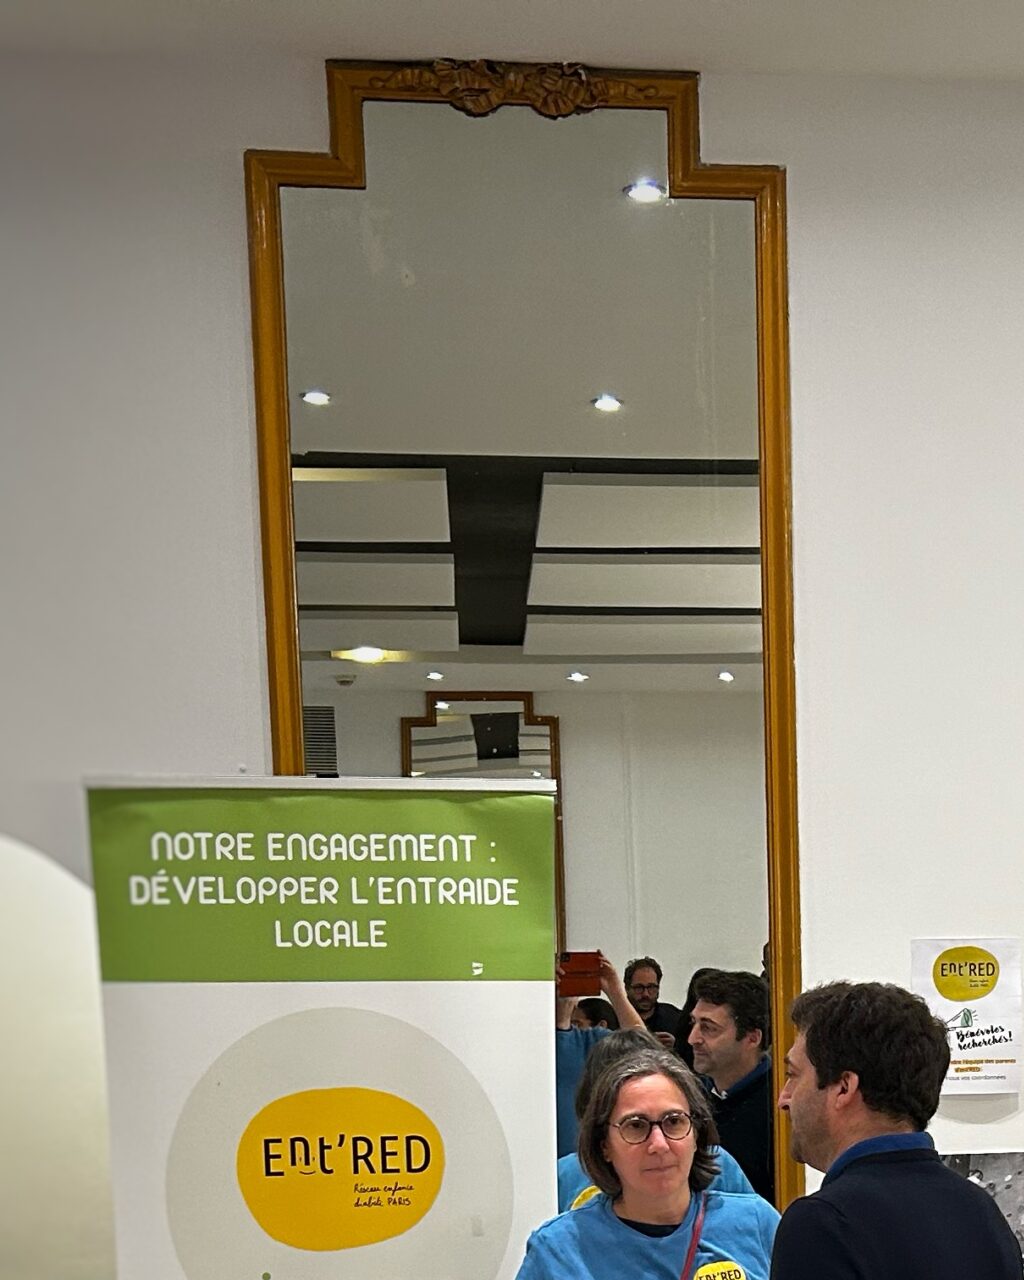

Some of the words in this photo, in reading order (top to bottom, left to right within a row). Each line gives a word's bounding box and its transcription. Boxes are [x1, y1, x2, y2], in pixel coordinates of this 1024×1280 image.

[151, 832, 255, 862] NOTRE
[268, 833, 477, 863] ENGAGEMENT
[129, 870, 339, 906] DÉVELOPPER
[351, 876, 519, 906] L'ENTRAIDE
[275, 920, 387, 948] LOCALE
[387, 1196, 412, 1206] PARIS
